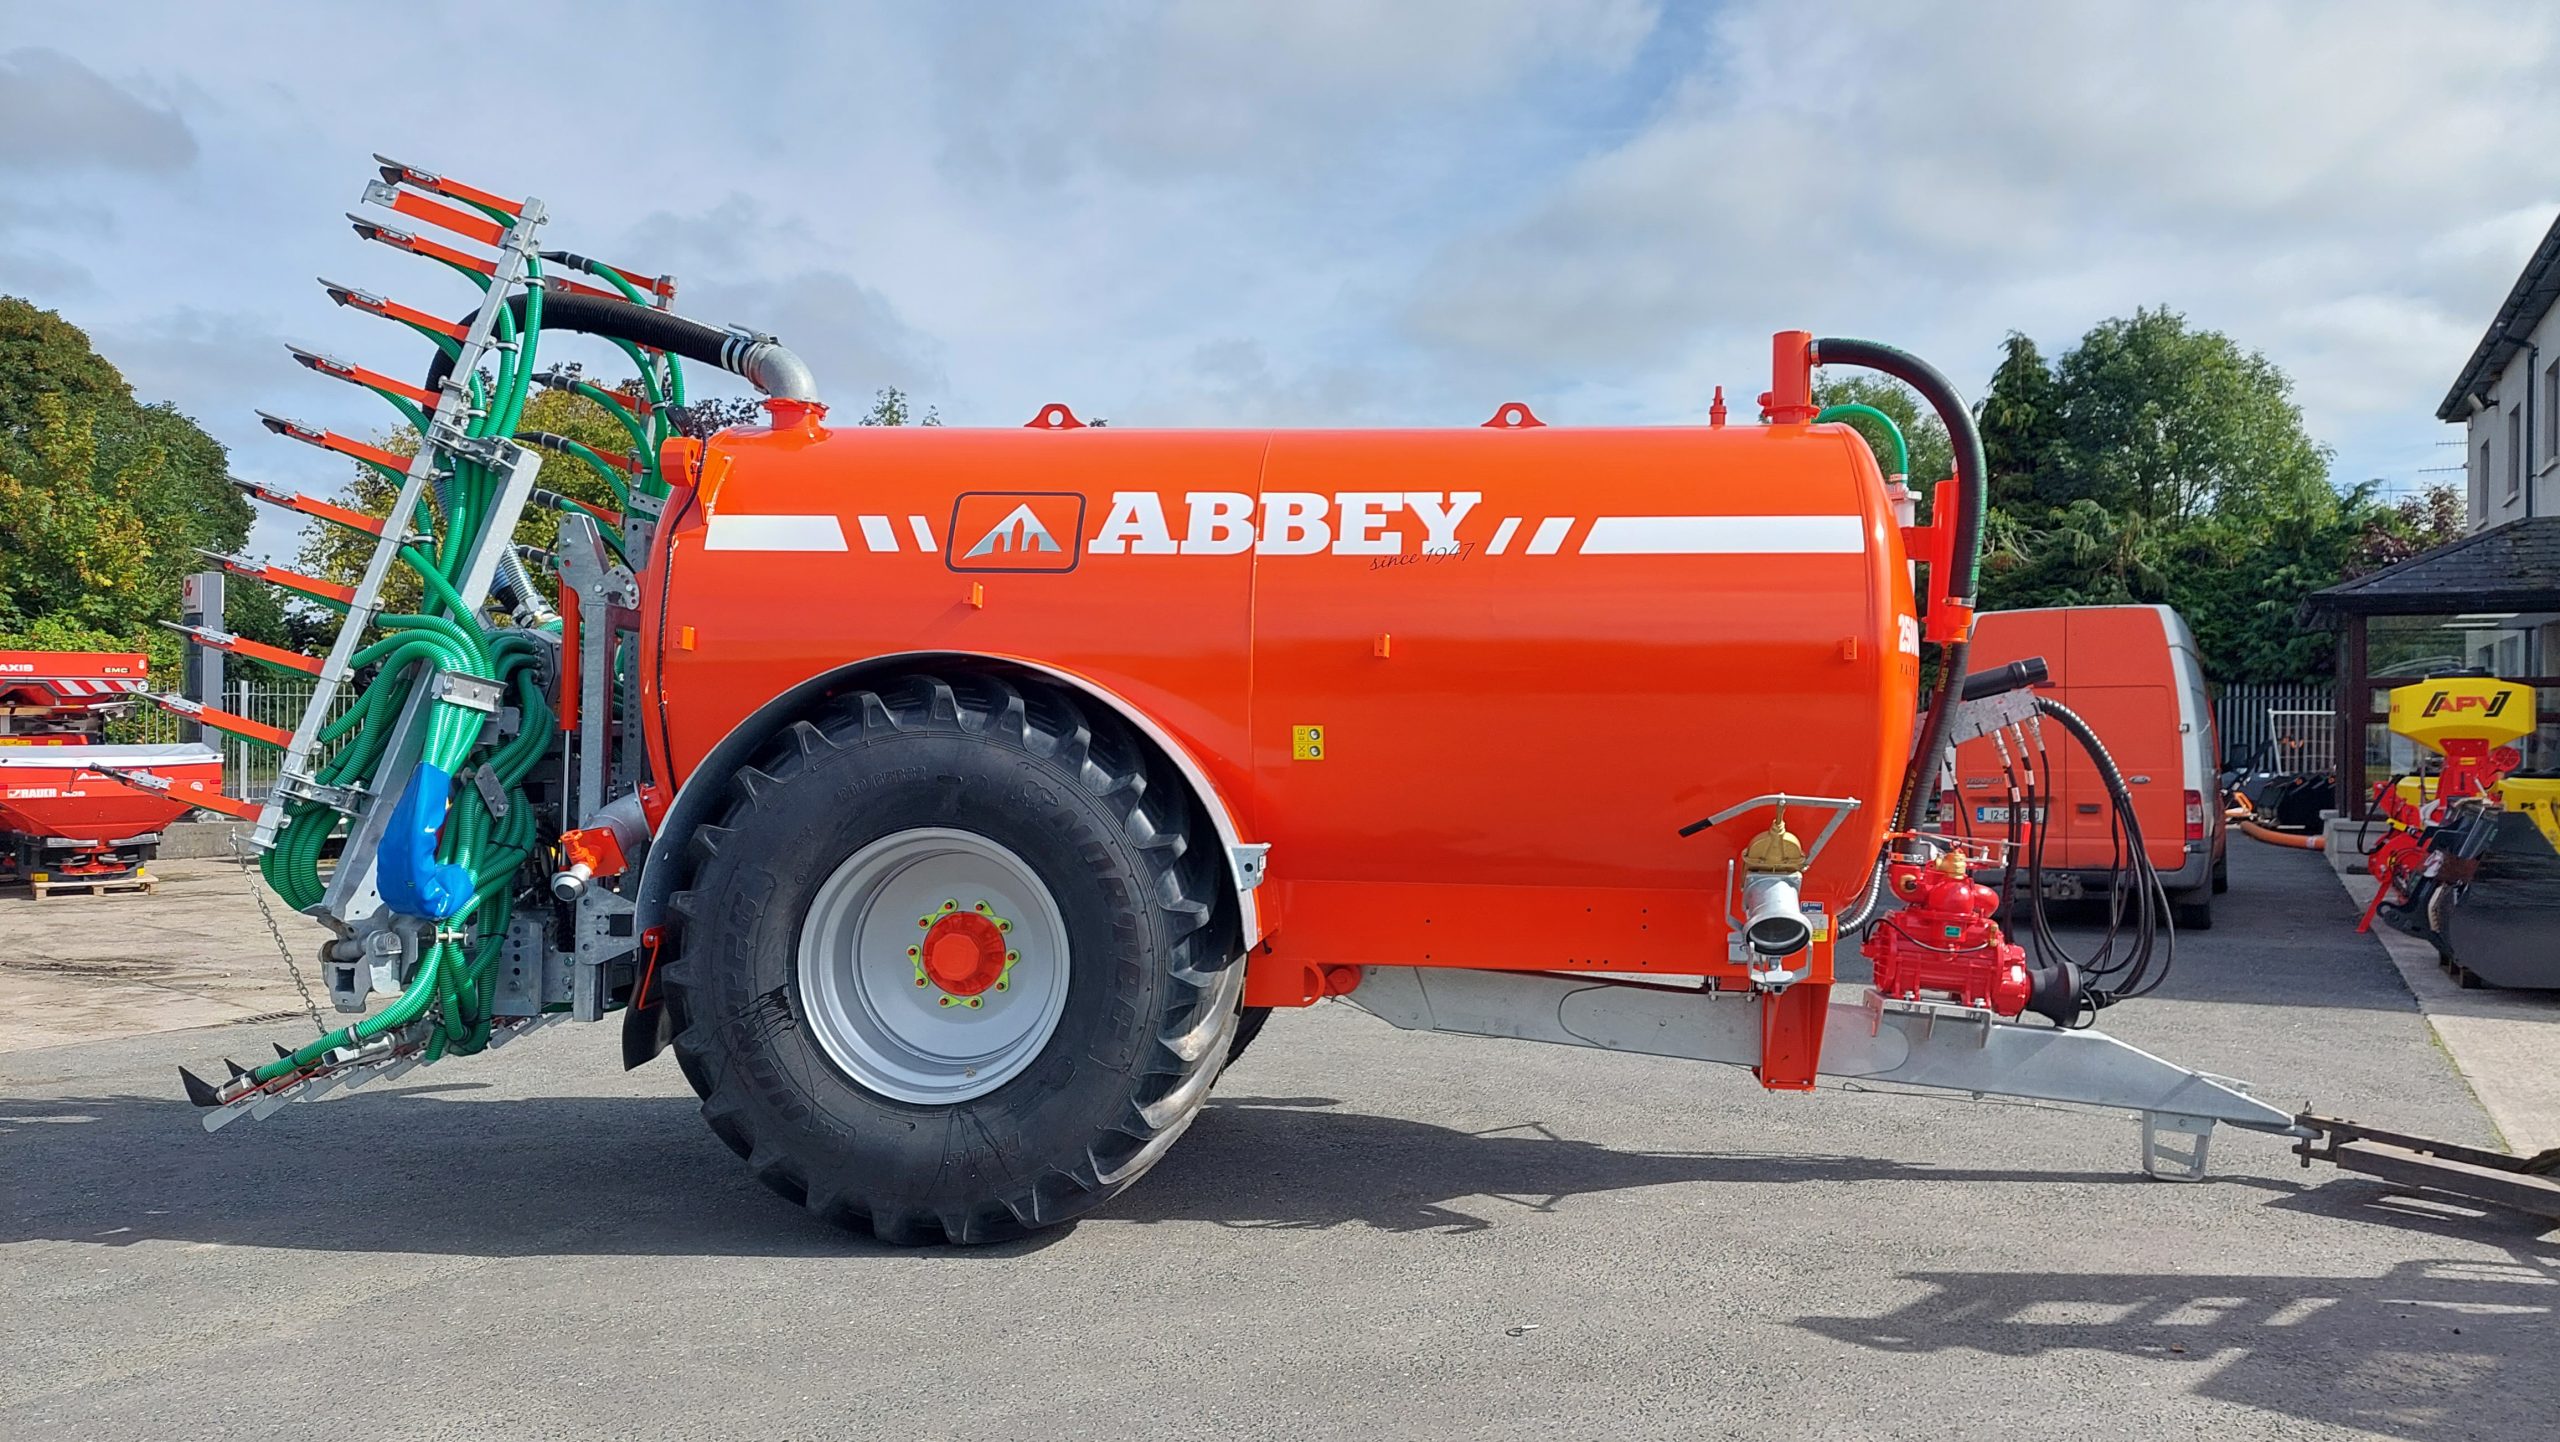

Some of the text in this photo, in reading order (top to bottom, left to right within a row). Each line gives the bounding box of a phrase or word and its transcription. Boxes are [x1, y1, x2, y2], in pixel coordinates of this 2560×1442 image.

[1087, 491, 1482, 555] ABBEY
[1369, 542, 1476, 570] since 1947
[0, 663, 34, 672] AXIS
